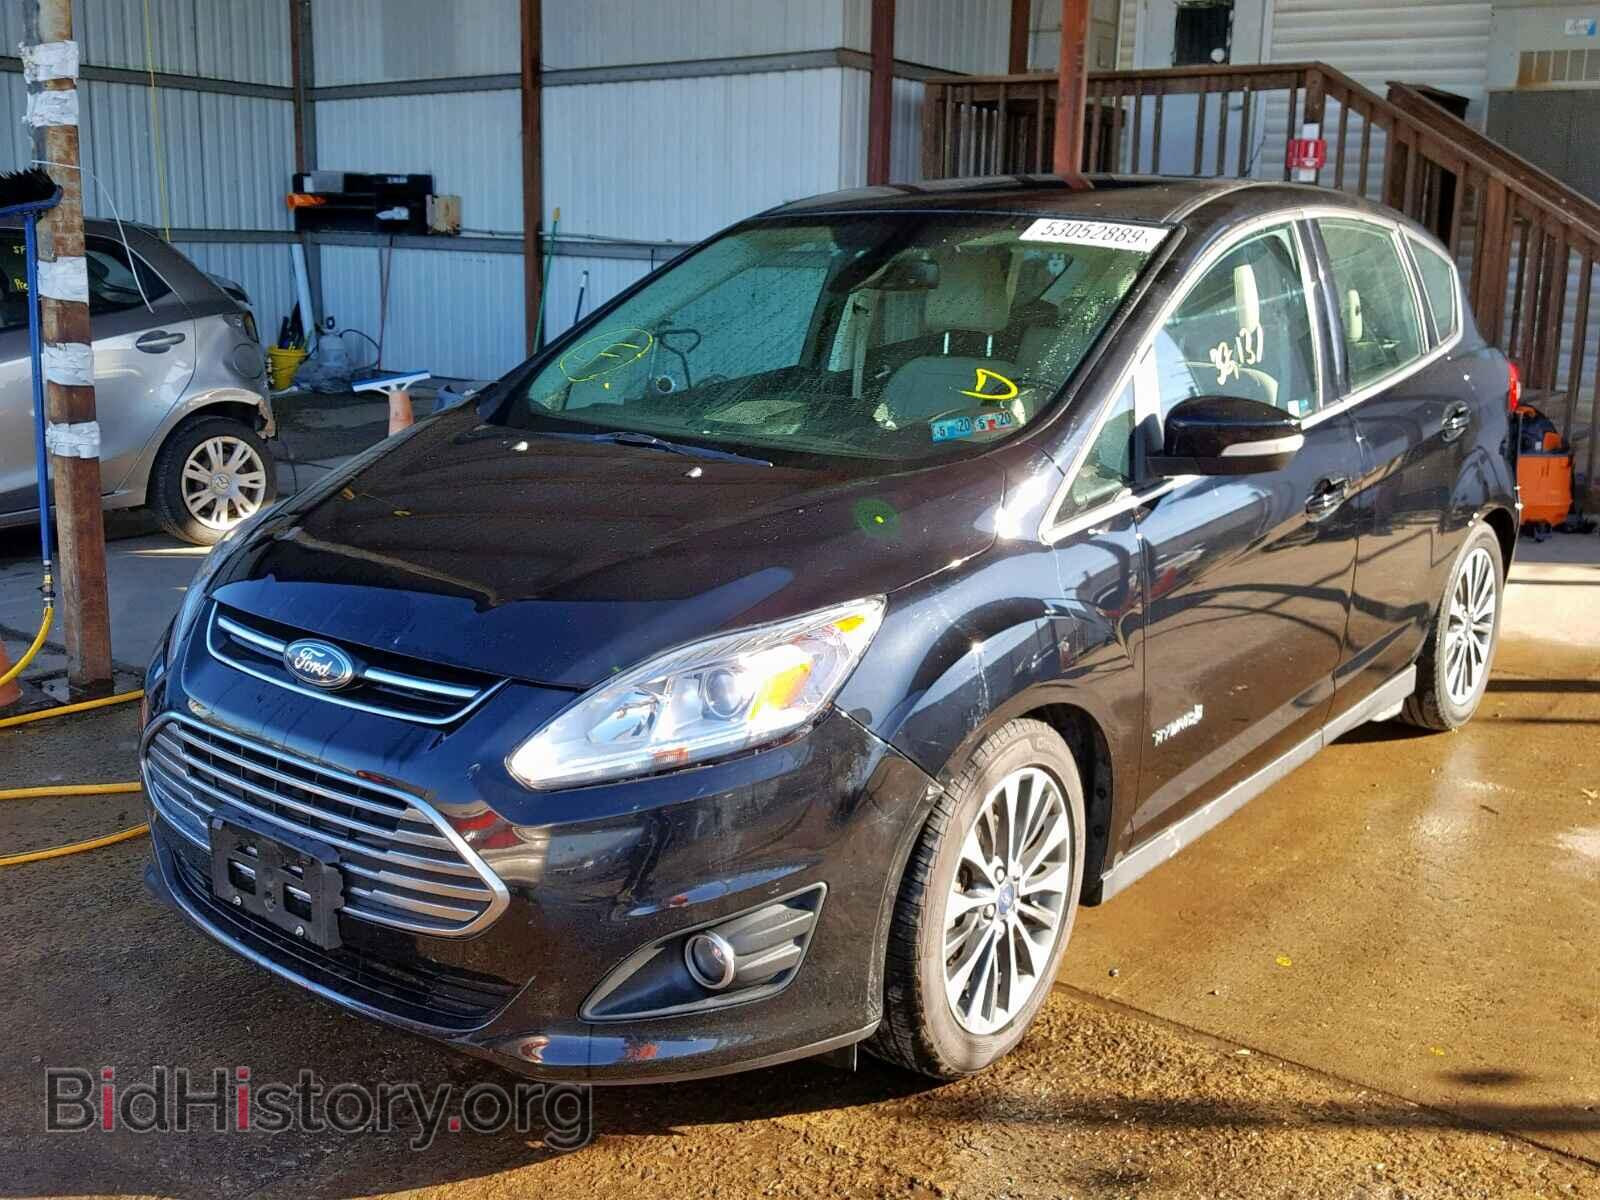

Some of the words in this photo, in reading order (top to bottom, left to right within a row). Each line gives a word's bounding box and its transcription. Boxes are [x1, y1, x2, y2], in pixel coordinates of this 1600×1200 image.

[1040, 220, 1145, 244] 53052889
[958, 368, 1018, 399] D
[959, 419, 971, 432] 20
[294, 647, 334, 677] Ford
